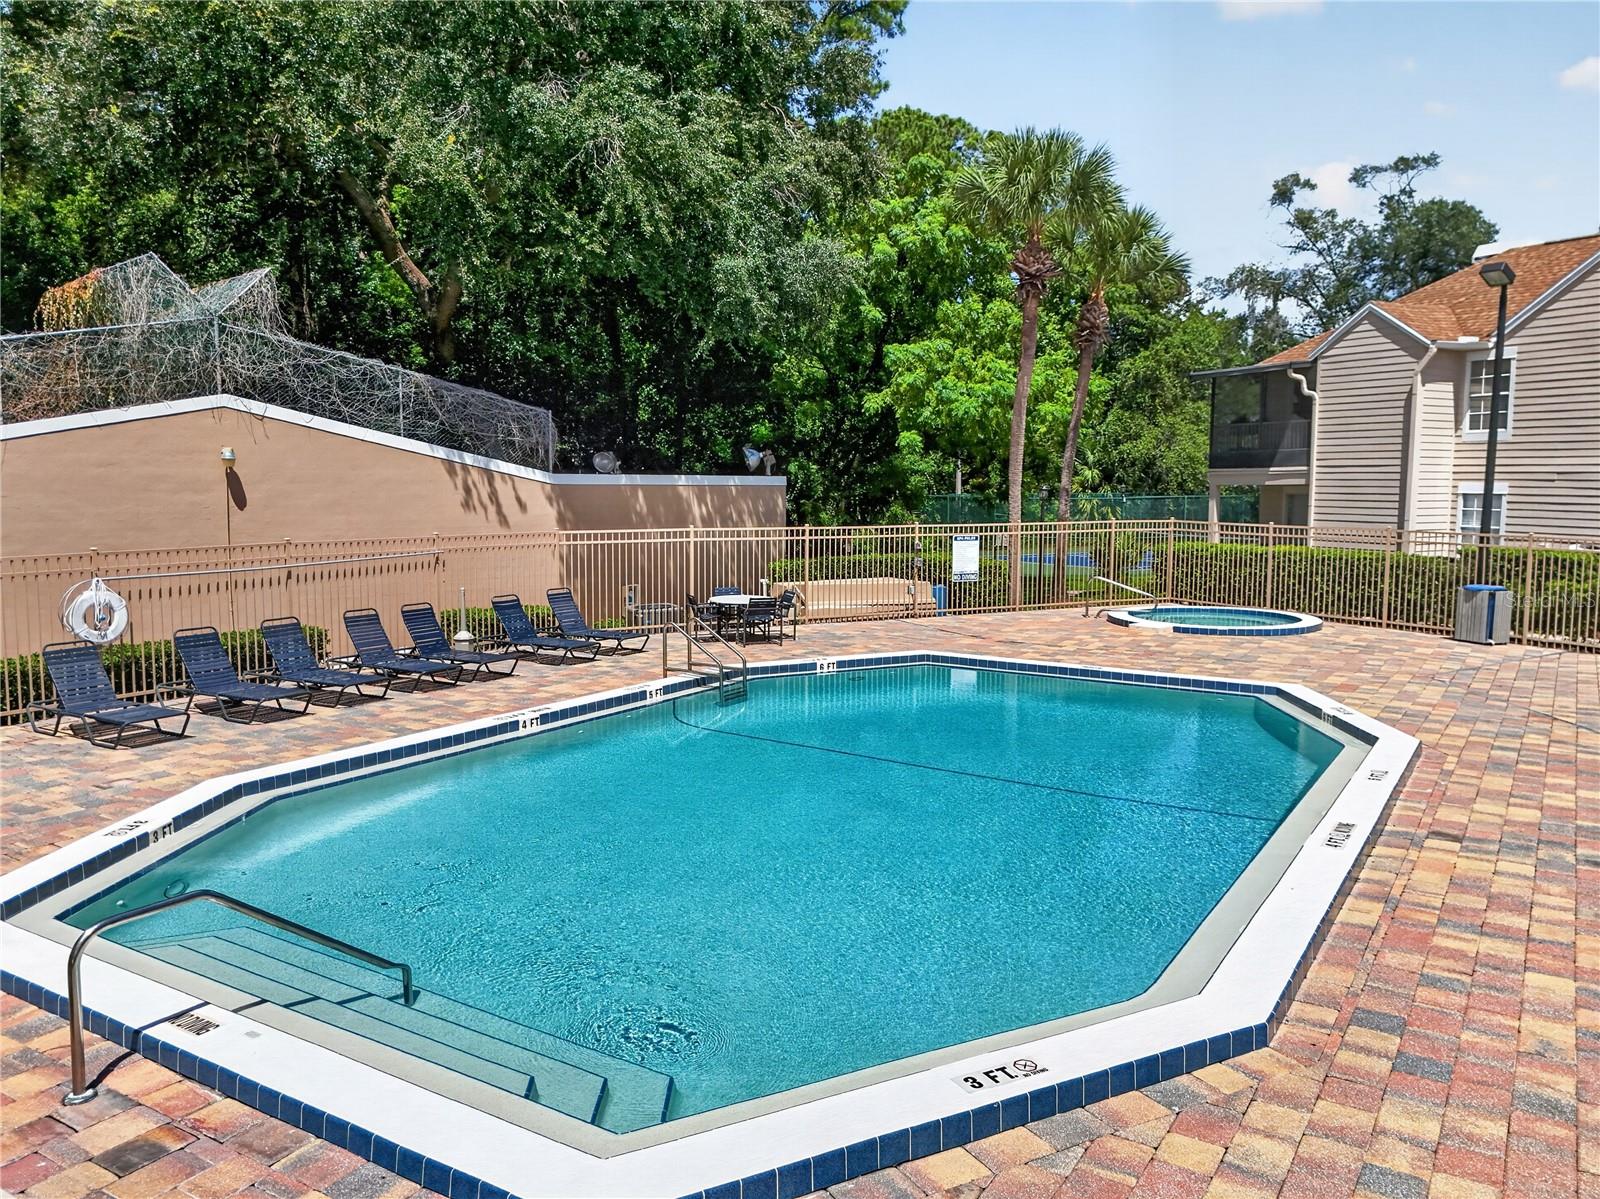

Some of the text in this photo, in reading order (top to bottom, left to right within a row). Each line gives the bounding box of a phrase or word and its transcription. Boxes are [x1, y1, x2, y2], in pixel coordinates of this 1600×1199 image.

[827, 662, 836, 671] FT
[648, 688, 663, 699] 5 FT
[521, 717, 540, 729] 4 FT
[153, 822, 173, 844] 3 FT
[963, 1066, 1019, 1089] 3 FT.
